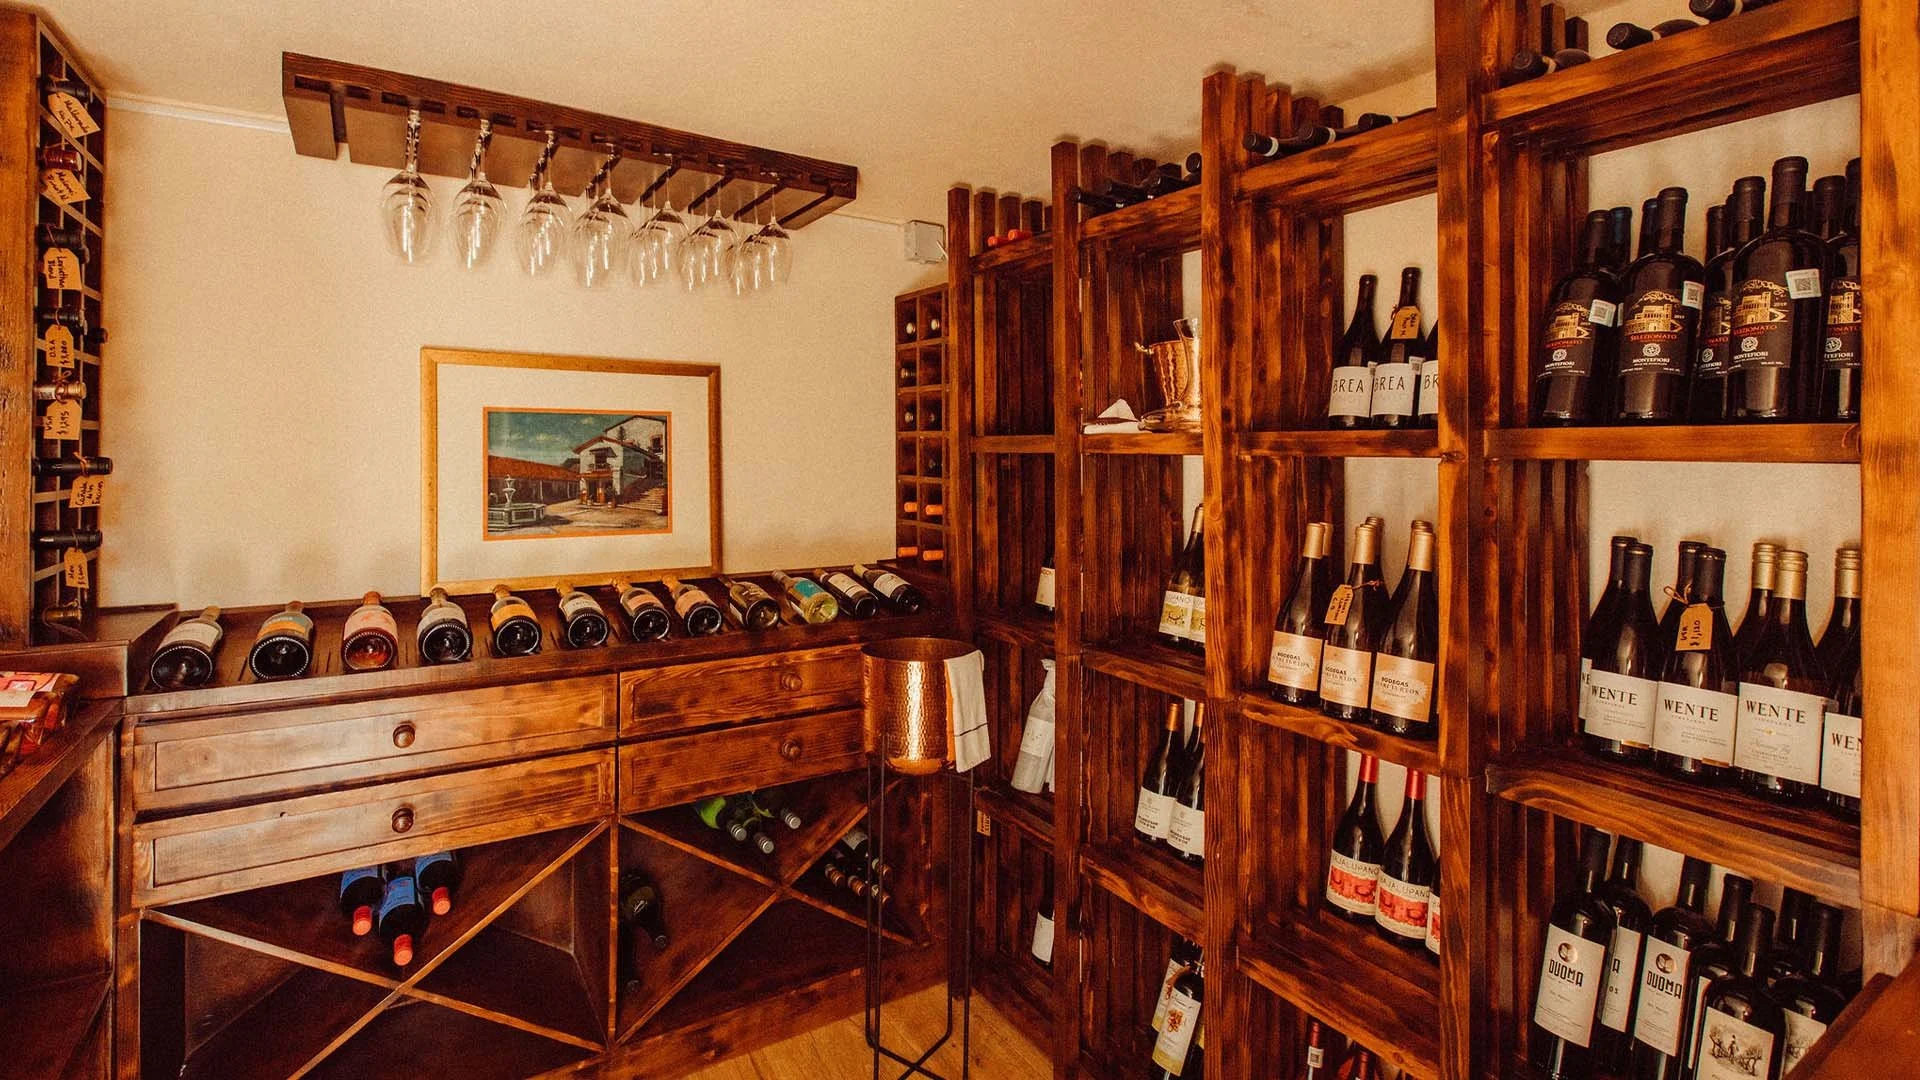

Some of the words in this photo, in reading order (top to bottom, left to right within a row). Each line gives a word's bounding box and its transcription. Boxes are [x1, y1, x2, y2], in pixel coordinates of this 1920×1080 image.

[1333, 378, 1364, 394] BREA
[1374, 376, 1405, 391] BREA
[1423, 374, 1439, 390] BR
[1381, 676, 1409, 688] BODEGAS
[1591, 685, 1638, 706] WENTE
[1664, 698, 1719, 722] WENTE
[1745, 699, 1807, 724] WENTE
[1831, 732, 1862, 751] WEN
[1548, 958, 1584, 988] DUOMA
[1646, 969, 1683, 1000] DUOMA
